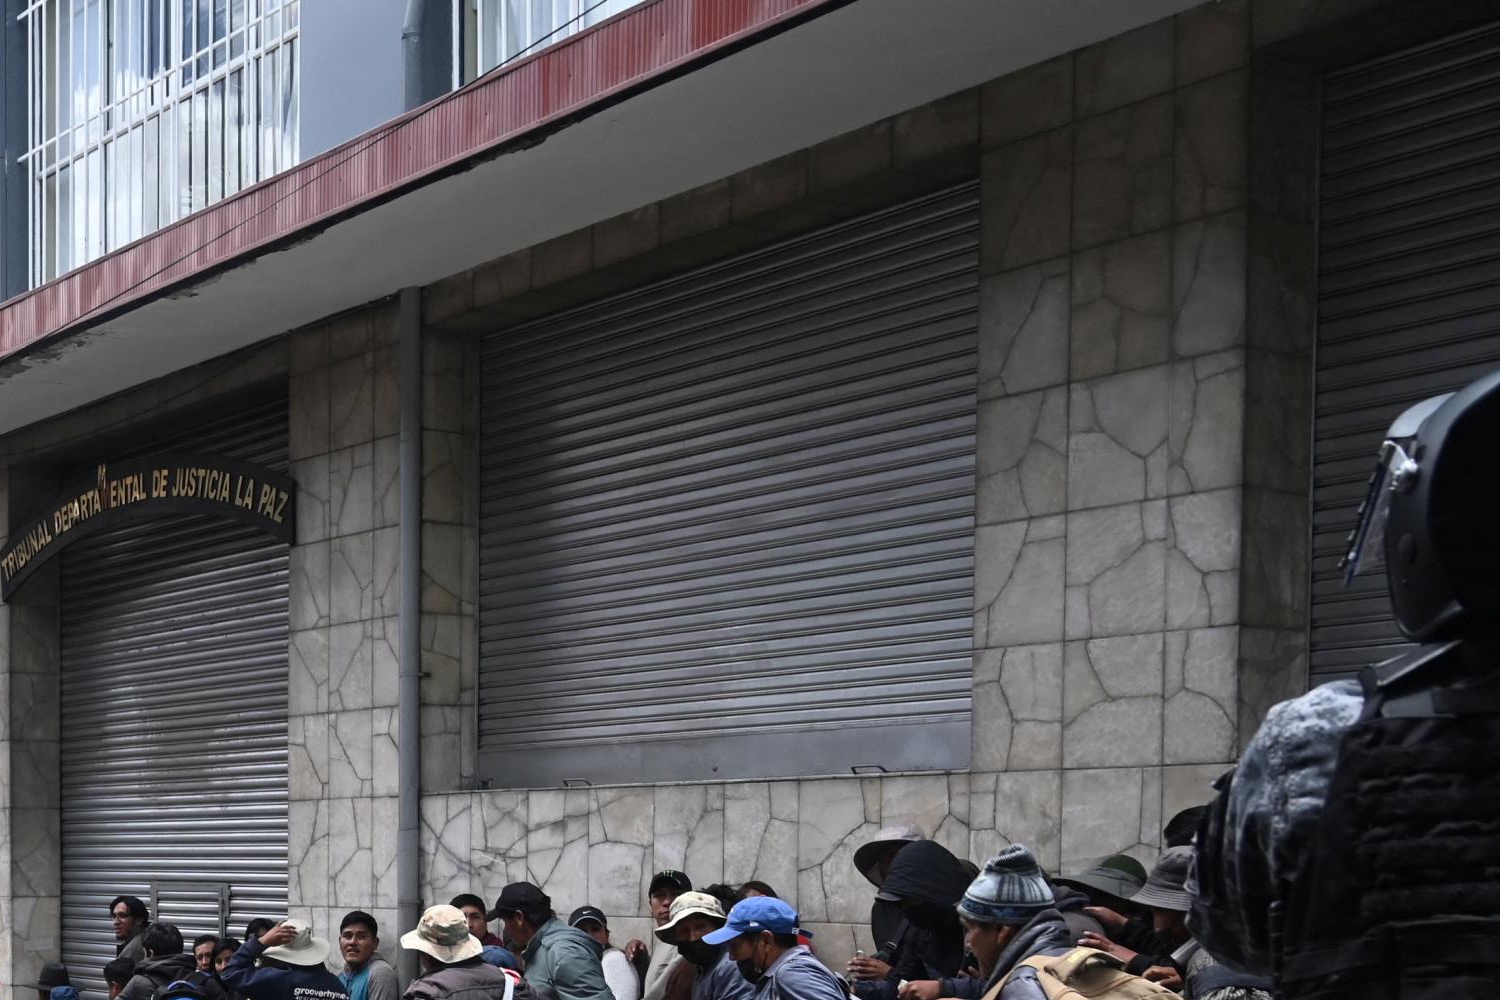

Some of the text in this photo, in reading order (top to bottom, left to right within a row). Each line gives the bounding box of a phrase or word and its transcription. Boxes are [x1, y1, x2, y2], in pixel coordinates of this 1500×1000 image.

[1, 464, 289, 582] TRIBUNAL DEPARTAMENTAL DE JUSTICIA LA PAZ
